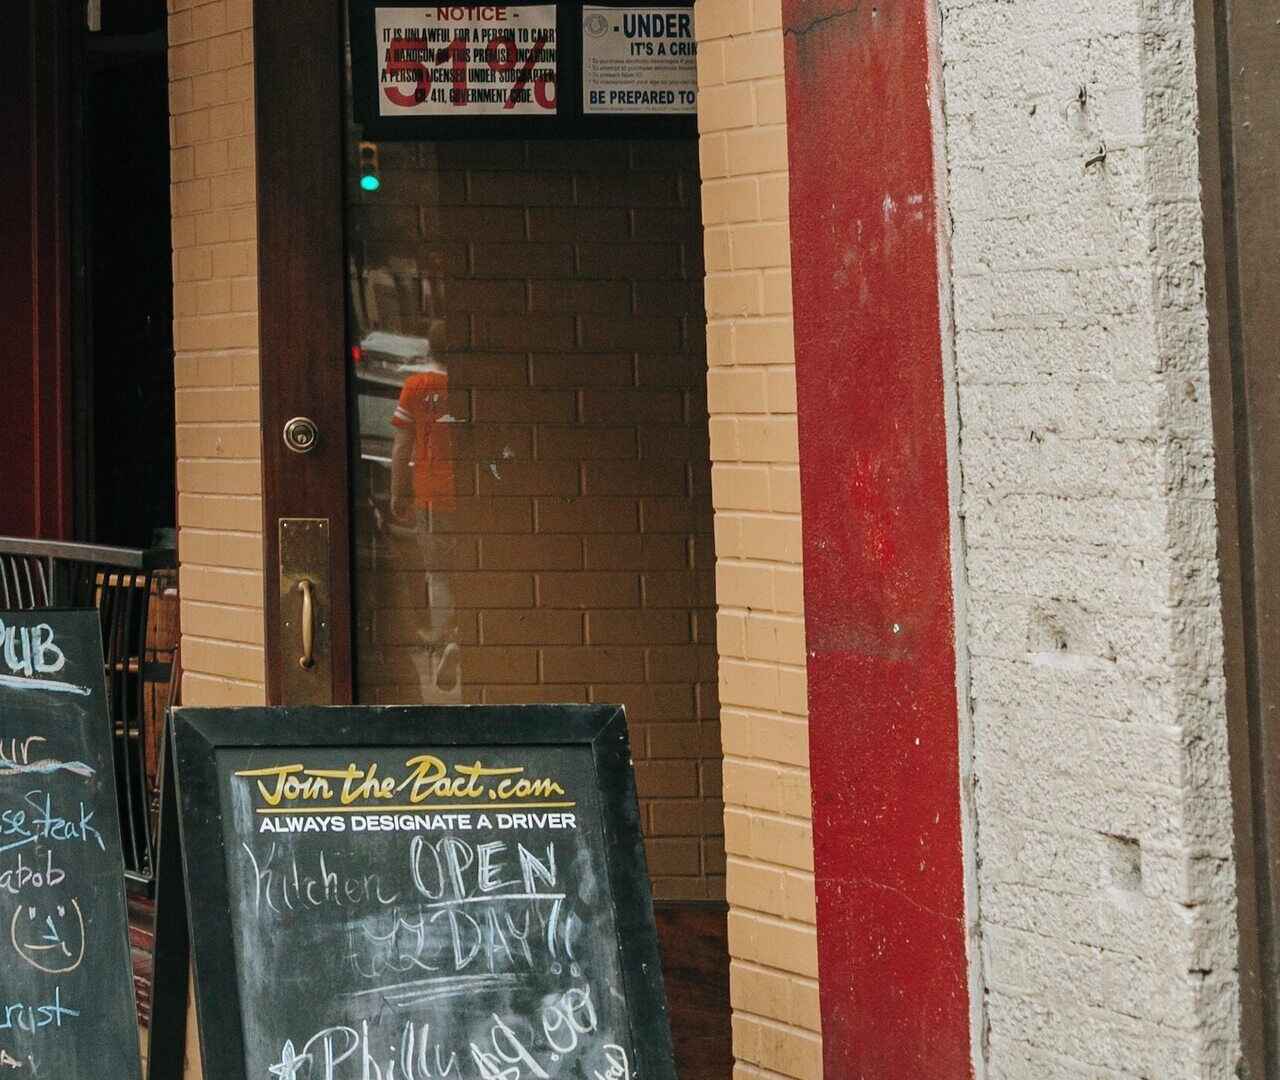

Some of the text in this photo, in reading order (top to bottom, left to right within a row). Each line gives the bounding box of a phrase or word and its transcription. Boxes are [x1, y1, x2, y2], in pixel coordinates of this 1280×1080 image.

[436, 7, 508, 21] NOTICE
[623, 13, 691, 38] UNDER
[405, 28, 451, 43] UNLAWFUL
[473, 28, 480, 43] A
[482, 27, 516, 43] PERSON
[518, 27, 529, 43] TO
[630, 41, 654, 56] IT'S
[657, 41, 666, 56] A
[384, 36, 556, 109] 51%
[468, 69, 496, 83] UNDER
[590, 90, 696, 105] BE PREPARED TO
[235, 764, 333, 805] Join
[304, 763, 397, 805] the
[260, 813, 576, 833] ALWAYS DESIGNATE A DRIVER
[410, 835, 558, 901] OPEN
